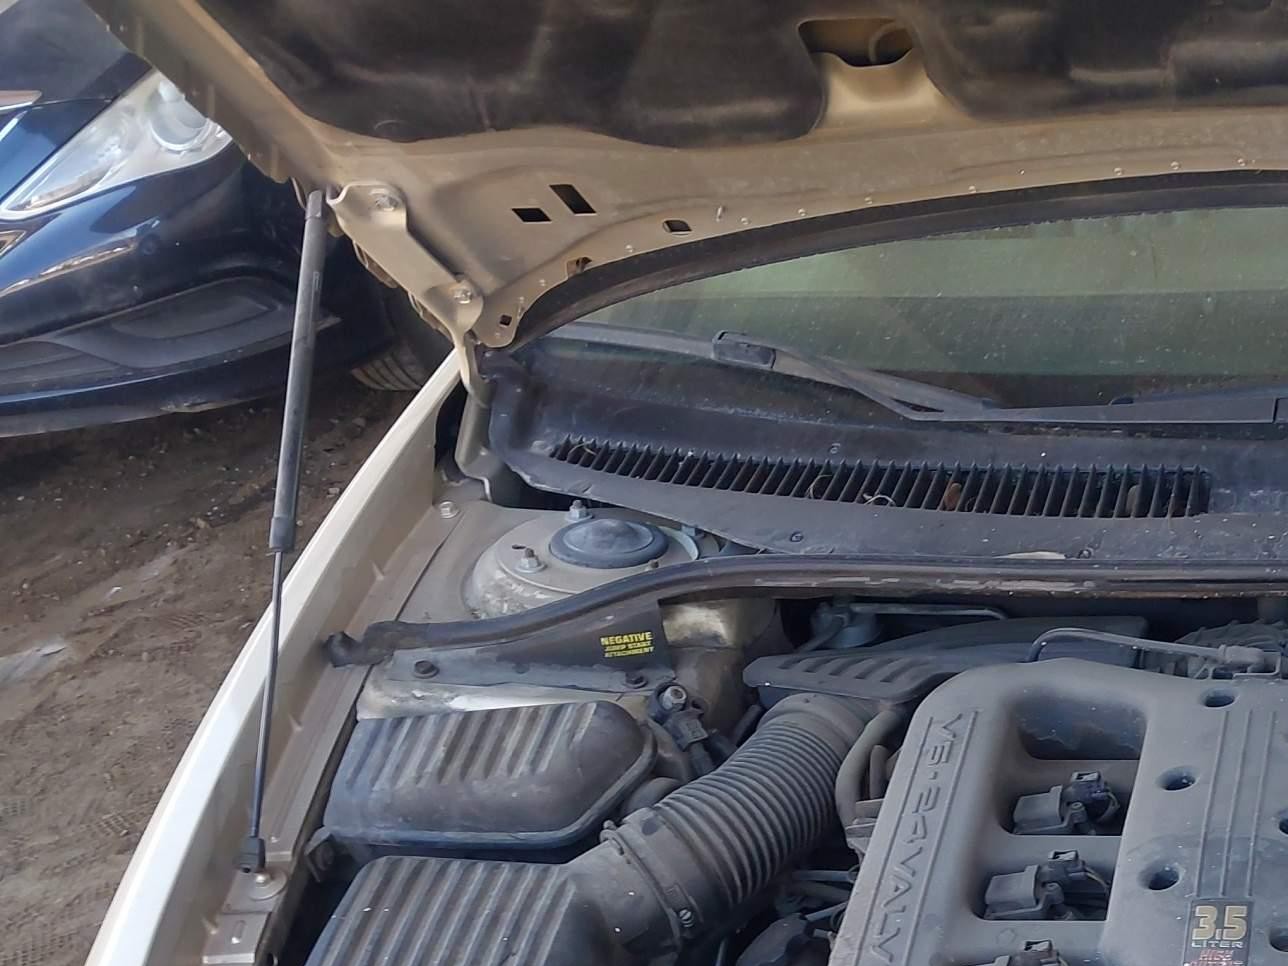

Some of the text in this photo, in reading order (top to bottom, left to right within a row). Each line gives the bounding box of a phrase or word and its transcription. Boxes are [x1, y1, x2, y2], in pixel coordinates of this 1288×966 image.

[600, 632, 653, 646] NEGATIVE
[1191, 905, 1249, 941] 3.5
[1191, 940, 1245, 948] LITER
